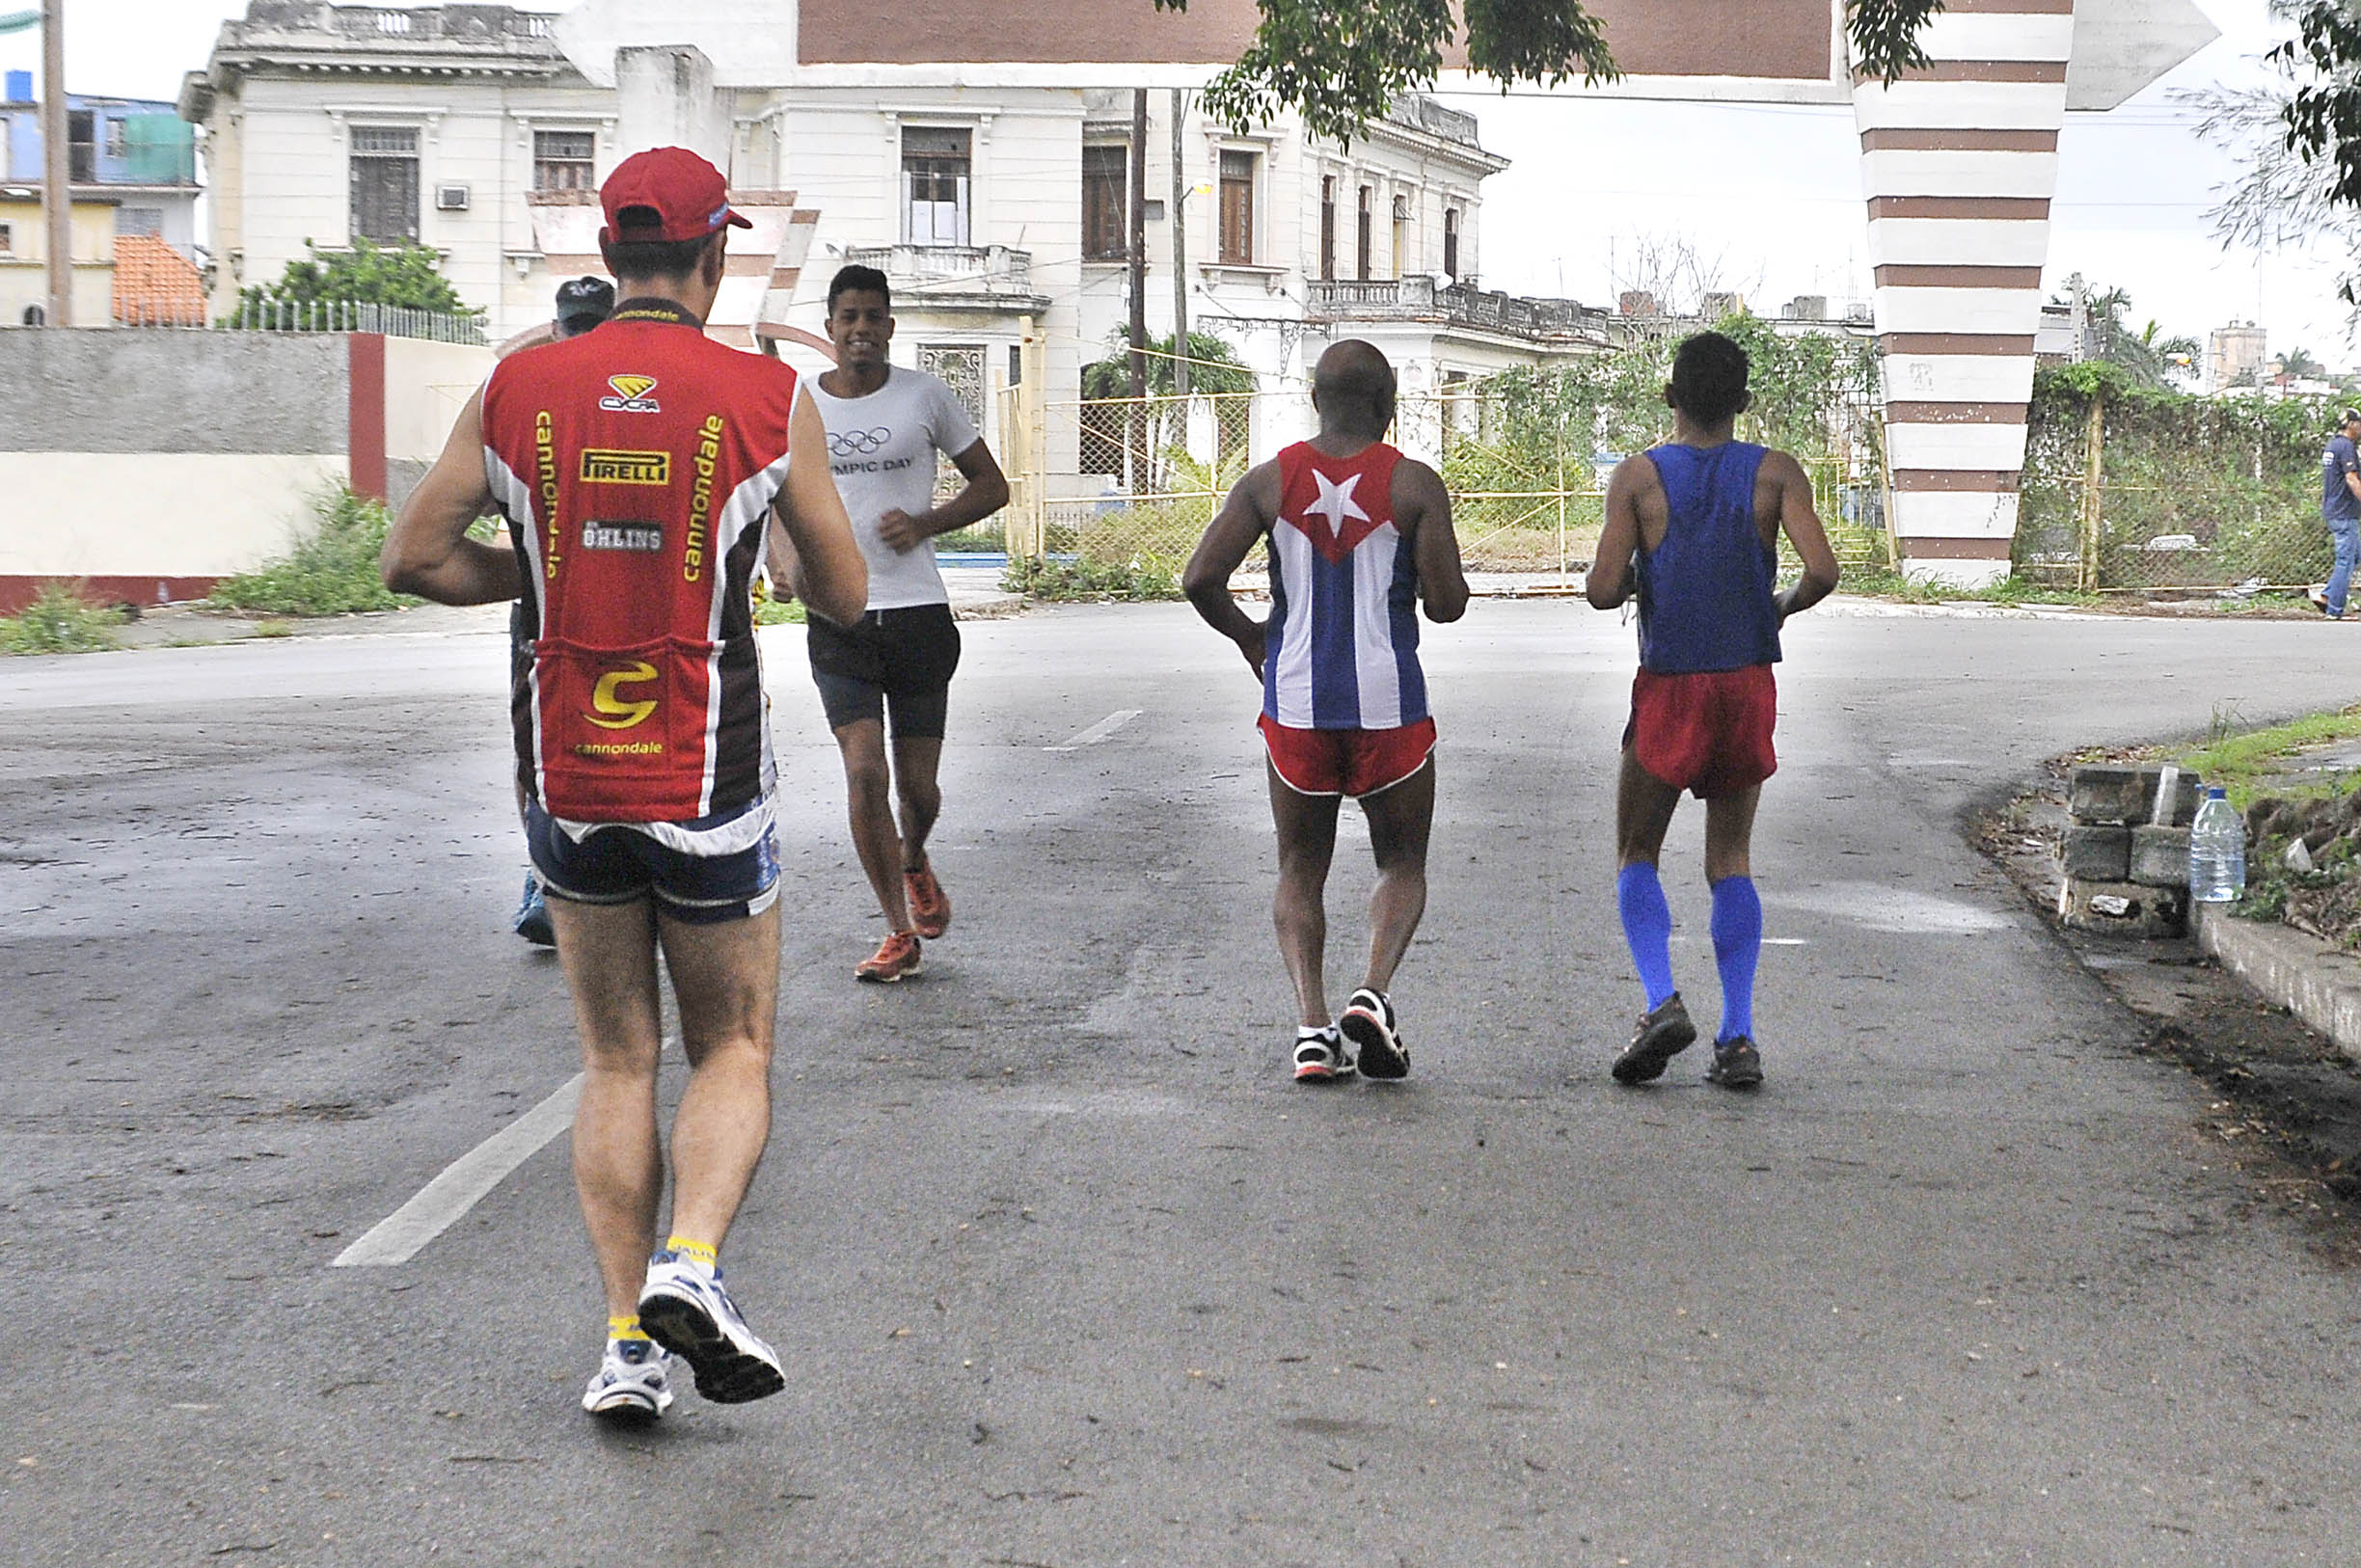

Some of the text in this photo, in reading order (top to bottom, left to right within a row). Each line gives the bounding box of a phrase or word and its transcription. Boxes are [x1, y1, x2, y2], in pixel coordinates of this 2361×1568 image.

[583, 452, 666, 481] PIRELLI
[684, 414, 723, 581] cannondale
[575, 742, 663, 754] cannondale
